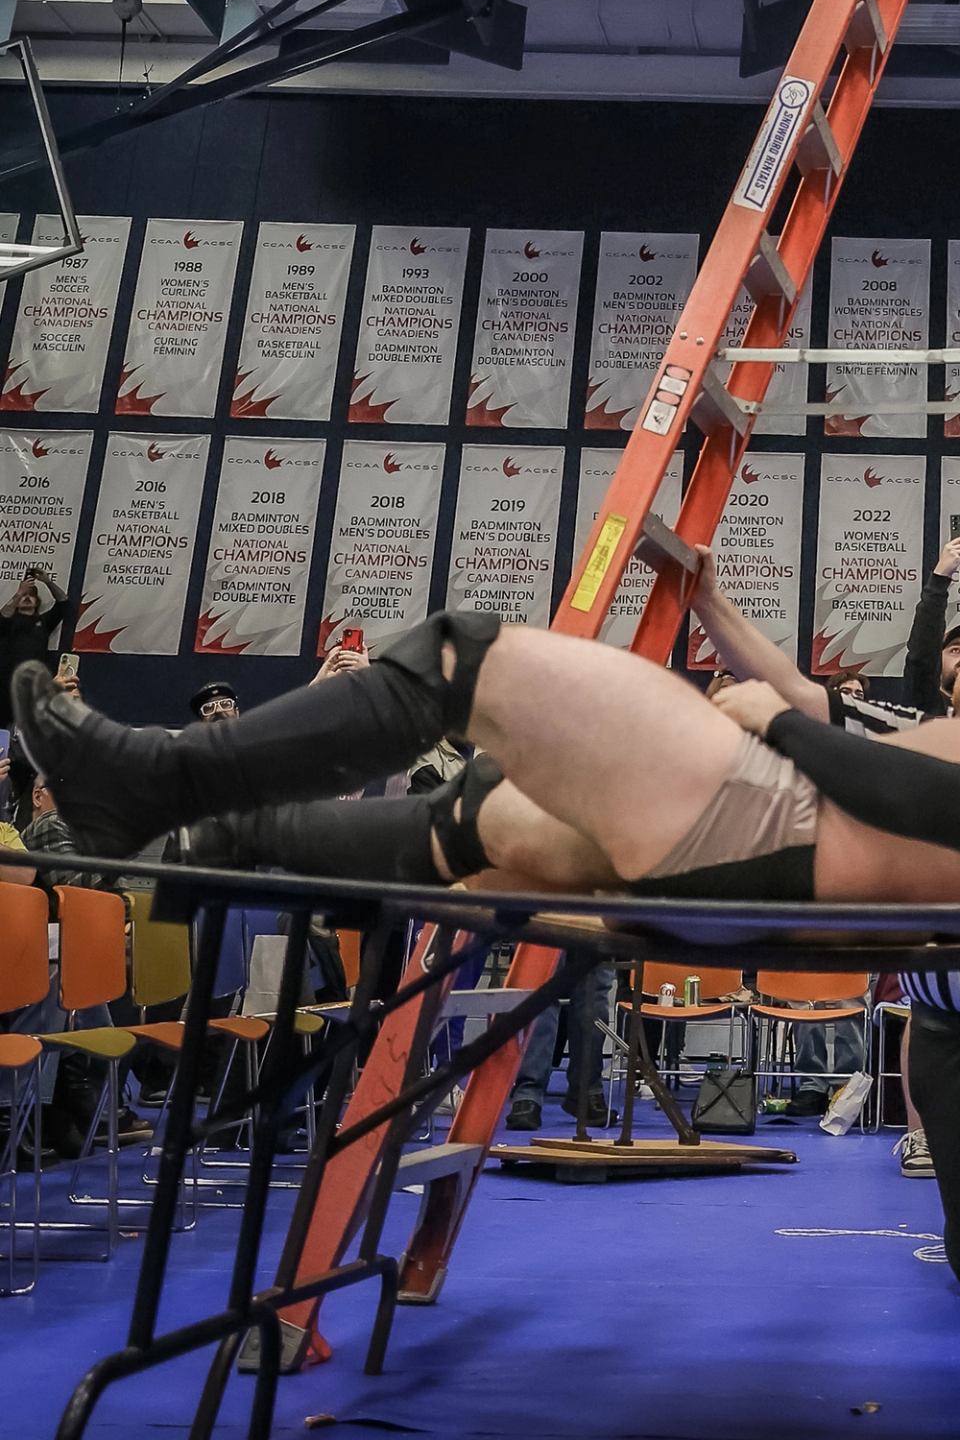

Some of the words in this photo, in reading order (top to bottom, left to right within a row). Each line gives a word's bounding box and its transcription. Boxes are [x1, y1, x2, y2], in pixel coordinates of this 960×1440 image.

[770, 110, 793, 157] SNOWBIRD
[61, 258, 88, 268] 1987
[173, 262, 202, 272] 1988
[288, 265, 315, 276] 1989
[402, 268, 429, 278] 1993
[56, 276, 86, 284] MEN'S
[511, 272, 548, 282] 2000
[629, 275, 663, 285] 2002
[161, 278, 209, 288] WOMEN'S
[283, 282, 314, 290] MEN'S
[862, 280, 896, 291] 2008
[50, 284, 89, 293] SOCCER
[162, 288, 207, 297] CURLING
[382, 285, 444, 294] BADMINTON
[497, 289, 560, 298] BADMINTON
[266, 291, 328, 300] BASKETBALL
[372, 294, 406, 304] MIXED
[407, 296, 453, 304] DOUBLES
[613, 292, 675, 301] BADMINTON
[42, 297, 92, 306] NATIONAL
[156, 300, 206, 310] NATIONAL
[848, 298, 910, 306] BADMINTON
[24, 306, 108, 318] CHAMPIONS
[268, 304, 320, 312] NATIONAL
[384, 307, 436, 316] NATIONAL
[138, 310, 223, 322] CHAMPIONS
[251, 313, 336, 325] CHAMPIONS
[499, 311, 551, 320] NATIONAL
[616, 314, 668, 322] NATIONAL
[33, 319, 93, 328] CANADIENS
[148, 322, 208, 331] CANADIENS
[366, 316, 452, 328] CHAMPIONS
[482, 320, 568, 332] CHAMPIONS
[852, 320, 905, 328] NATIONAL
[262, 325, 322, 334] CANADIENS
[377, 329, 438, 338] CANADIENS
[40, 333, 81, 342] SOCCER
[493, 333, 554, 342] CANADIENS
[834, 329, 922, 341] CHAMPIONS
[154, 337, 198, 346] CURLING
[258, 340, 321, 349] BASKETBALL
[32, 343, 85, 352] MASCULIN
[375, 344, 438, 353] BADMINTON
[491, 348, 554, 356] BADMINTON
[262, 350, 314, 358] MASCULIN
[368, 353, 410, 362] DOUBLE
[412, 355, 442, 363] MIXTE
[19, 476, 50, 488] 2016
[136, 481, 166, 492] 2016
[251, 492, 285, 504] 2018
[371, 496, 405, 508] 2018
[729, 494, 768, 506] 2020
[131, 500, 165, 509] MEN'S
[491, 500, 525, 512] 2019
[113, 510, 179, 520] BASKETBALL
[231, 512, 299, 522] BADMINTON
[853, 510, 890, 522] 2022
[351, 517, 420, 527] BADMINTON
[116, 524, 171, 534] NATIONAL
[218, 523, 255, 532] MIXED
[258, 525, 309, 534] DOUBLES
[340, 528, 375, 537] MEN'S
[377, 529, 430, 539] DOUBLES
[730, 527, 766, 536] MIXED
[844, 531, 899, 540] WOMEN'S
[97, 534, 188, 548] CHAMPIONS
[234, 539, 288, 548] NATIONAL
[721, 538, 774, 548] DOUBLES
[354, 543, 410, 554] NATIONAL
[835, 542, 906, 552] BASKETBALL
[108, 548, 172, 558] CANADIENS
[214, 549, 306, 563] CHAMPIONS
[334, 553, 427, 567] CHAMPIONS
[718, 554, 775, 564] NATIONAL
[842, 558, 898, 567] NATIONAL
[103, 564, 172, 575] BASKETBALL
[224, 565, 290, 575] CANADIENS
[346, 569, 413, 580] CANADIENS
[822, 568, 916, 581] CHAMPIONS
[107, 575, 164, 586] MASCULIN
[221, 582, 290, 592] BADMINTON
[341, 585, 412, 596] BADMINTON
[835, 584, 902, 594] CANADIENS
[213, 592, 258, 602] DOUBLE
[261, 594, 296, 604] MIXTE
[352, 597, 399, 608] DOUBLE
[832, 600, 904, 610] BASKETBALL
[344, 608, 404, 619] MASCULIN
